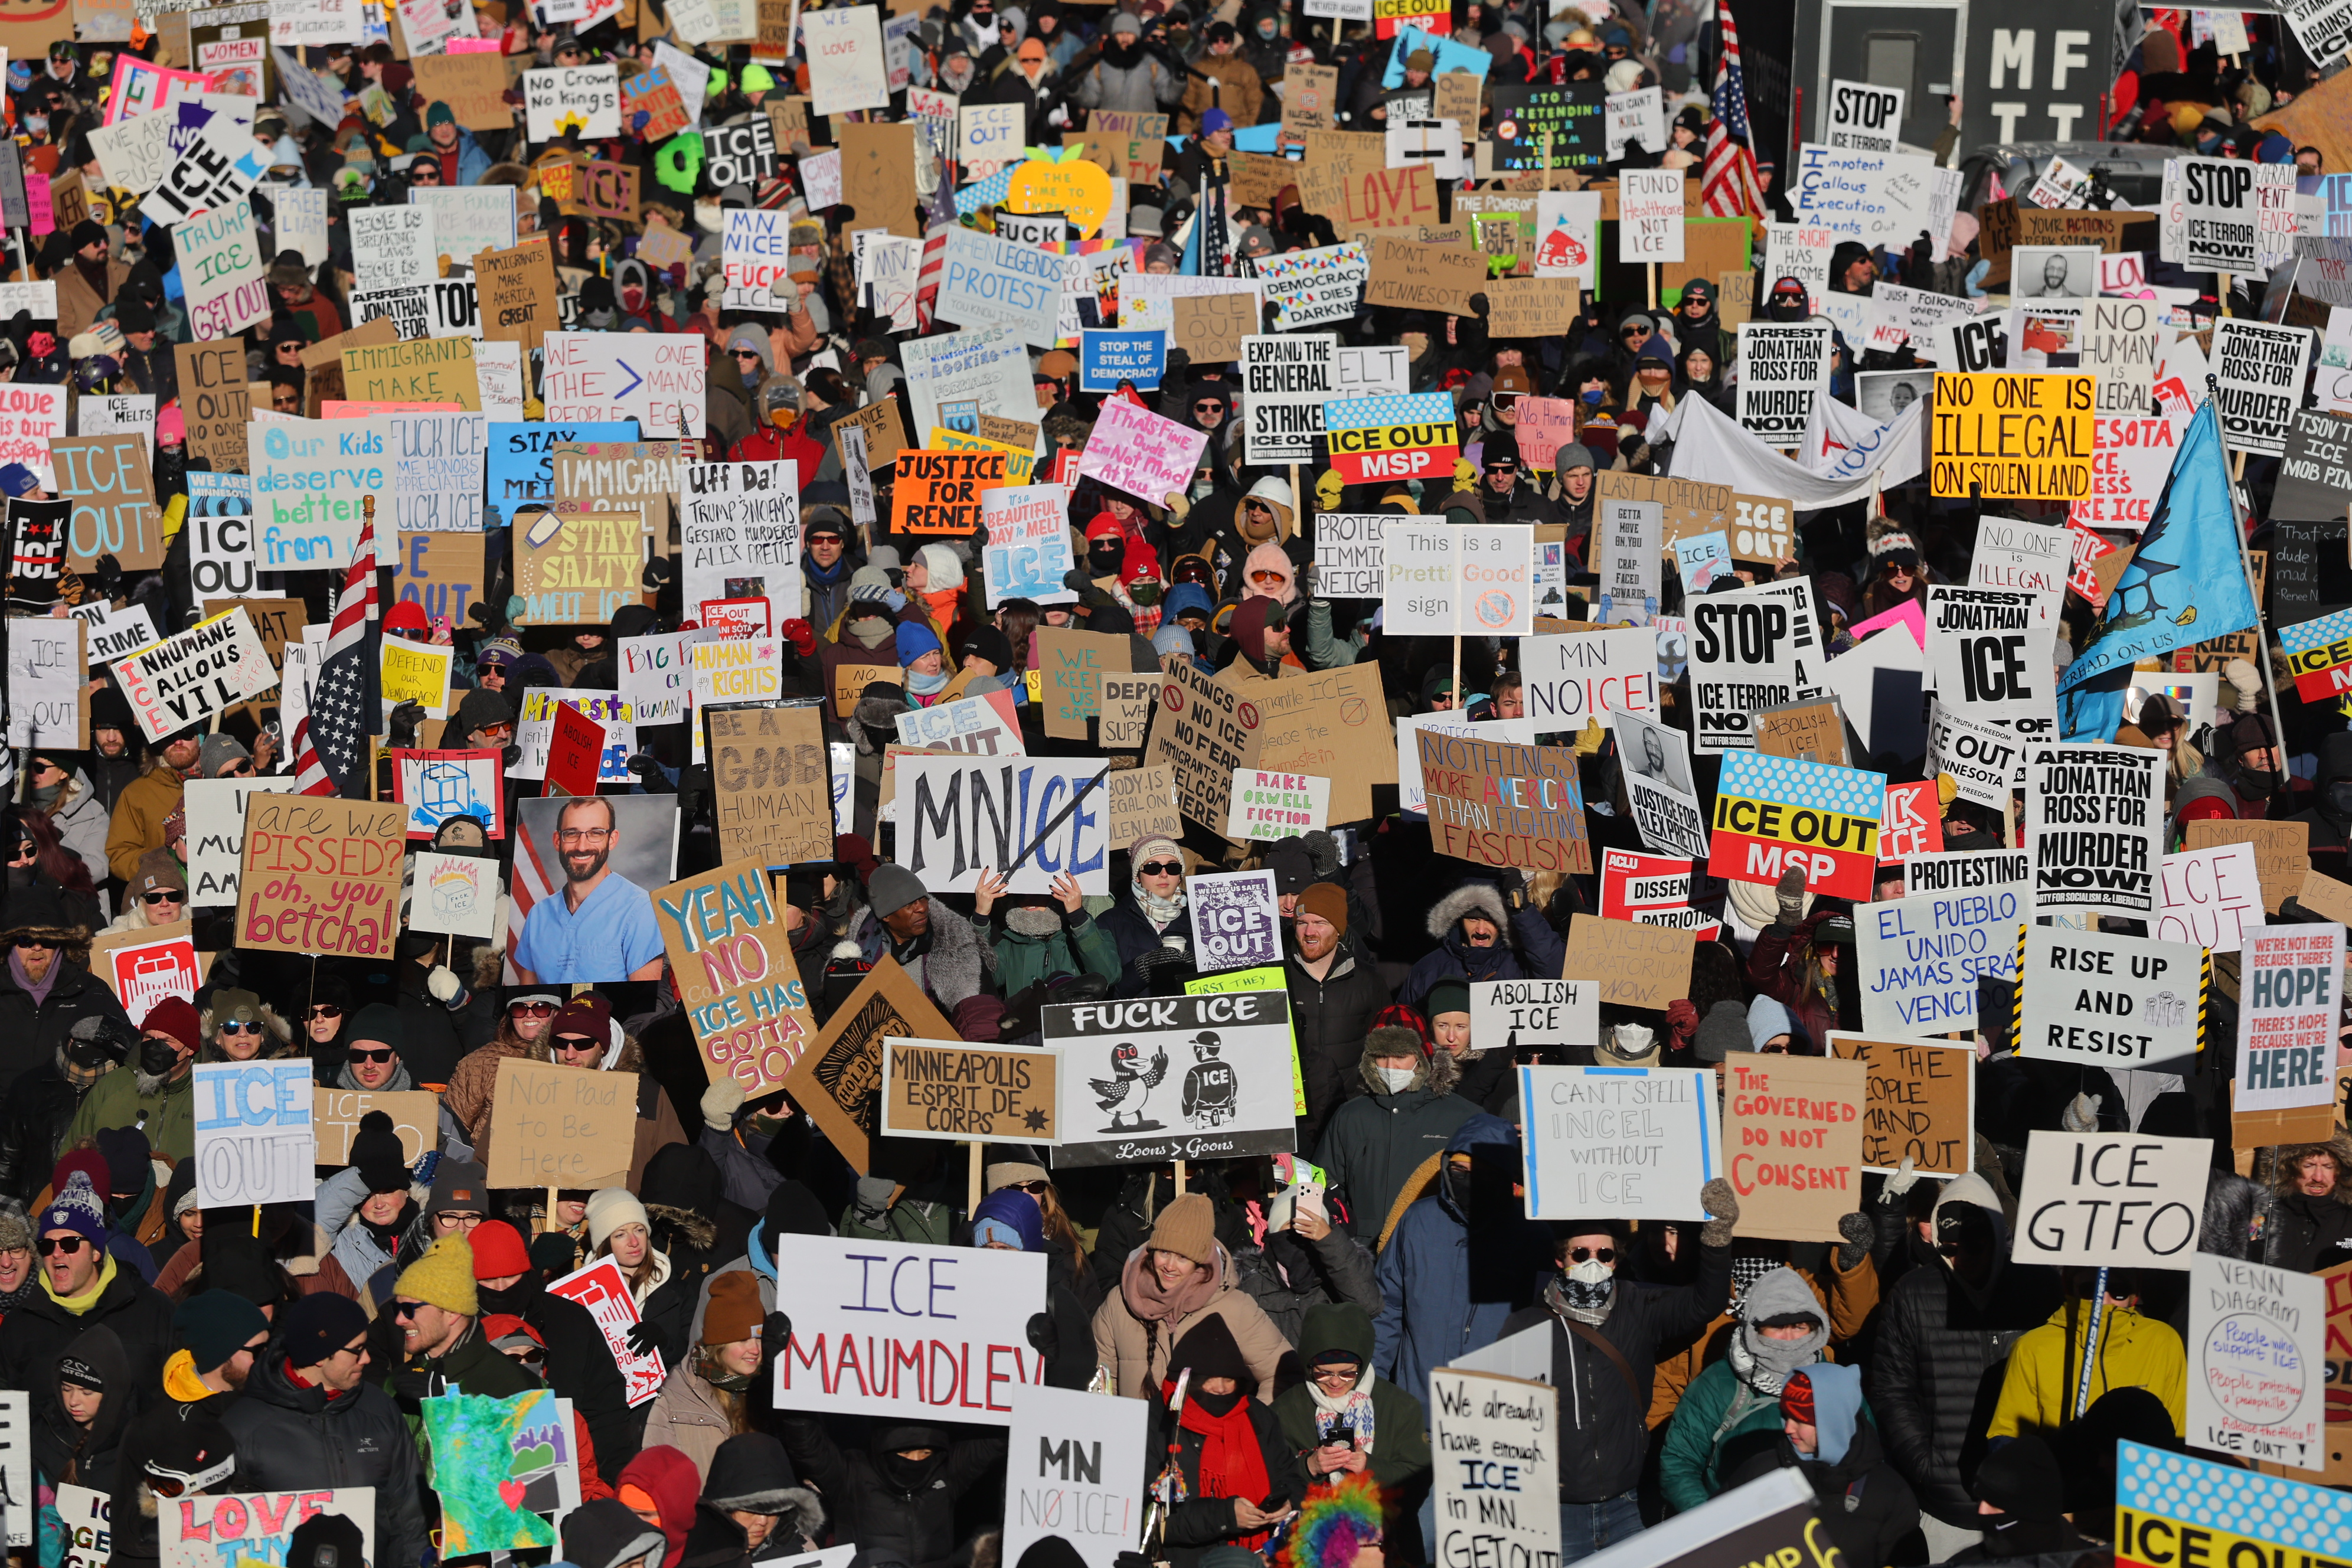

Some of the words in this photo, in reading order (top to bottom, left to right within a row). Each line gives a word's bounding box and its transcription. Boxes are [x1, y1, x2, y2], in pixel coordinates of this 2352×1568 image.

[204, 41, 259, 59] WOMEN
[822, 40, 857, 55] LOVE
[530, 76, 554, 90] No
[625, 66, 668, 97] ICE
[532, 94, 554, 109] No
[1835, 87, 1896, 129] STOP
[970, 108, 1012, 125] ICE
[703, 122, 770, 162] ICE
[971, 128, 1011, 145] OUT
[709, 148, 775, 187] OUT
[1803, 150, 1884, 171] Impotent
[1344, 165, 1432, 223] LOVE
[1627, 175, 1680, 195] FUND
[1802, 172, 1867, 193] Callous
[2186, 162, 2251, 208] STOP
[277, 190, 324, 215] FREE
[1799, 191, 1886, 214] Execution
[731, 211, 777, 234] MN
[1482, 222, 1510, 238] ICE
[1642, 218, 1668, 234] NOT
[2188, 219, 2206, 238] ICE
[2210, 221, 2254, 244] TERROR
[724, 234, 784, 256] NICE
[1486, 239, 1515, 254] OUT
[1634, 236, 1665, 253] ICE
[2189, 240, 2254, 259] NOW!
[194, 243, 254, 287] ICE
[480, 250, 545, 274] IMMIGRANTS
[496, 272, 525, 289] MAKE
[726, 263, 785, 288] FUCK
[1266, 267, 1368, 296] DEMOCRACY
[492, 289, 536, 307] AMERICA
[1319, 286, 1353, 300] DIES
[1370, 281, 1470, 308] MINNESOTA
[192, 288, 231, 342] GET
[235, 276, 271, 322] OUT
[498, 305, 538, 328] GREAT
[2093, 303, 2146, 332] NO
[2220, 324, 2307, 344] ARREST
[1099, 341, 1126, 353] STOP
[1130, 340, 1153, 352] THE
[2222, 336, 2301, 366] JONATHAN
[1099, 354, 1134, 367] STEAL
[1137, 354, 1152, 365] OF
[2221, 357, 2260, 381] ROSS
[2262, 364, 2293, 387] FOR
[1091, 367, 1159, 380] DEMOCRACY
[1249, 365, 1332, 393] GENERAL
[107, 398, 129, 411] ICE
[1936, 377, 1973, 407] NO
[1992, 378, 2044, 408] ONE
[2066, 378, 2092, 410] IS
[115, 410, 153, 423] MELTS
[1517, 402, 1538, 426] No
[1543, 410, 1573, 428] Human
[264, 427, 325, 460] Our
[339, 430, 384, 455] Kids
[1934, 414, 2091, 458] ILLEGAL
[53, 443, 142, 495] ICE
[256, 463, 384, 494] deserve
[896, 456, 1005, 479] JUSTICE
[1935, 463, 1966, 495] ON
[1970, 463, 2032, 496] STOLEN
[2038, 463, 2088, 497] LAND
[929, 482, 975, 503] FOR
[986, 499, 1060, 528] BEAUTIFUL
[1618, 508, 1641, 520] GETTA
[1735, 501, 1788, 532] ICE
[557, 520, 637, 554] STAY
[685, 527, 737, 545] GESTAPO
[1027, 517, 1061, 535] MELT
[263, 530, 334, 564] from
[1407, 533, 1449, 552] This
[1463, 533, 1479, 551] is
[1490, 538, 1502, 551] a
[1682, 545, 1716, 564] ICE
[1736, 530, 1789, 560] OUT
[695, 544, 741, 569] ALEX
[541, 554, 641, 590] SALTY
[1389, 563, 1452, 583] Pretti
[1463, 563, 1524, 583] Good
[707, 606, 723, 616] ICE
[729, 609, 749, 618] OUT
[1406, 596, 1449, 618] sign
[386, 649, 443, 674] DEFEND
[693, 642, 753, 670] HUMAN
[2061, 654, 2110, 688] TREAD
[2118, 641, 2145, 659] ON
[2151, 633, 2173, 649] US
[401, 674, 419, 685] OUR
[711, 666, 778, 697] RIGHTS
[381, 682, 438, 705] DEMOCRACY
[562, 723, 593, 752] ABOLISH
[1766, 714, 1829, 739] ABOLISH
[1954, 717, 1973, 729] TRUTH
[1980, 726, 2011, 741] FREEDOM
[1788, 734, 1819, 753] ICE!
[1930, 717, 1952, 751] ICE
[1955, 735, 2015, 770] OUT
[566, 753, 579, 771] ICE
[1255, 773, 1307, 792] MAKE
[1243, 790, 1313, 809] ORWELL
[257, 803, 331, 833] are
[348, 811, 397, 838] we
[1247, 808, 1311, 825] FICTION
[1496, 806, 1587, 839] FIGHTING
[1444, 824, 1589, 871] FASCISM!
[2038, 831, 2148, 873] MURDER
[1607, 854, 1638, 869] ACLU
[1607, 865, 1629, 874] Minnesota
[1910, 855, 2028, 891] PROTESTING
[2036, 868, 2154, 892] NOW!
[1207, 906, 1262, 933] ICE
[1208, 932, 1266, 956] OUT
[1908, 929, 1987, 963] UNIDO
[2254, 939, 2285, 952] WE'RE
[2287, 937, 2305, 950] NOT
[2308, 935, 2334, 949] HERE
[2050, 945, 2113, 976] RISE
[2131, 956, 2168, 981] UP
[2254, 953, 2294, 967] BECAUSE
[2297, 951, 2333, 965] THERE'S
[1491, 982, 1577, 1006] ABOLISH
[2252, 966, 2331, 1009] HOPE
[2075, 989, 2134, 1017] AND
[1509, 1007, 1559, 1031] ICE
[2047, 1024, 2154, 1060] RESIST
[509, 1072, 563, 1106] Not
[575, 1077, 618, 1106] Paid
[1203, 1069, 1229, 1086] ICE
[1734, 1067, 1769, 1092] THE
[1733, 1095, 1856, 1123] GOVERNED
[1115, 1141, 1166, 1160] Loons
[1185, 1137, 1234, 1157] Goons
[1742, 1127, 1768, 1146] DO
[1781, 1129, 1828, 1149] NOT
[2072, 1142, 2163, 1188] ICE
[2027, 1201, 2196, 1256] GTFO
[2219, 1260, 2285, 1297] VENN
[2210, 1288, 2300, 1332] DIAGRAM
[2226, 1321, 2269, 1347] People
[2209, 1426, 2245, 1450] ICE
[1459, 1459, 1522, 1492] ICE
